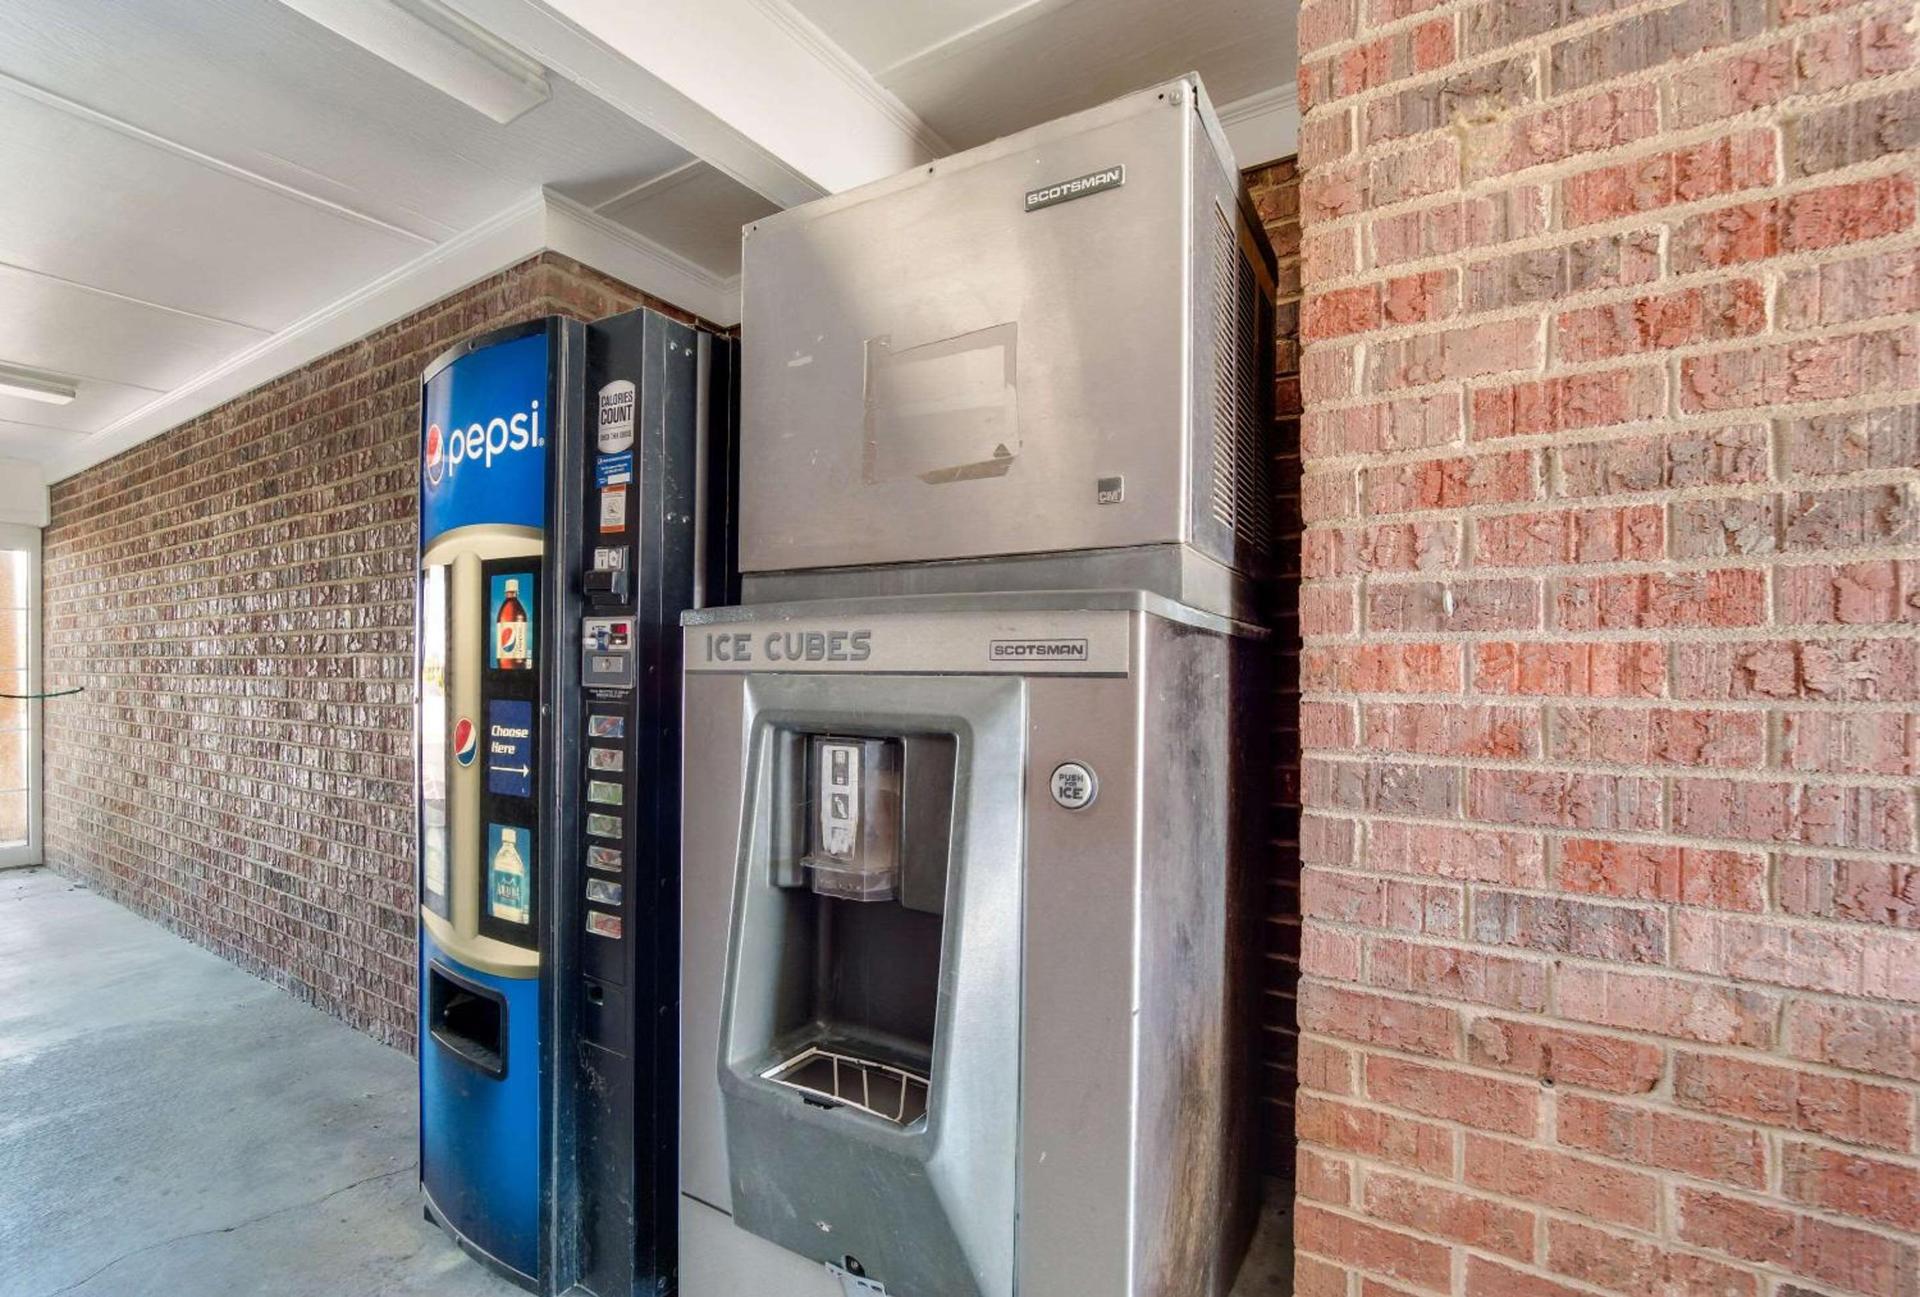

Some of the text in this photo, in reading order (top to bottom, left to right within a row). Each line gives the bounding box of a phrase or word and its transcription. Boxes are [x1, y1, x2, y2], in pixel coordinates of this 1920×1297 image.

[1027, 169, 1120, 205] SCOTSMAN
[601, 391, 633, 408] CALORIES
[601, 404, 633, 425] COUNT
[448, 400, 539, 477] pepsi
[706, 630, 872, 662] ICE CUBES
[994, 644, 1084, 656] SCOTSMAN
[491, 725, 529, 738] Choose
[491, 741, 516, 755] Here
[1059, 773, 1084, 782] PUSH
[1059, 786, 1083, 800] ICE
